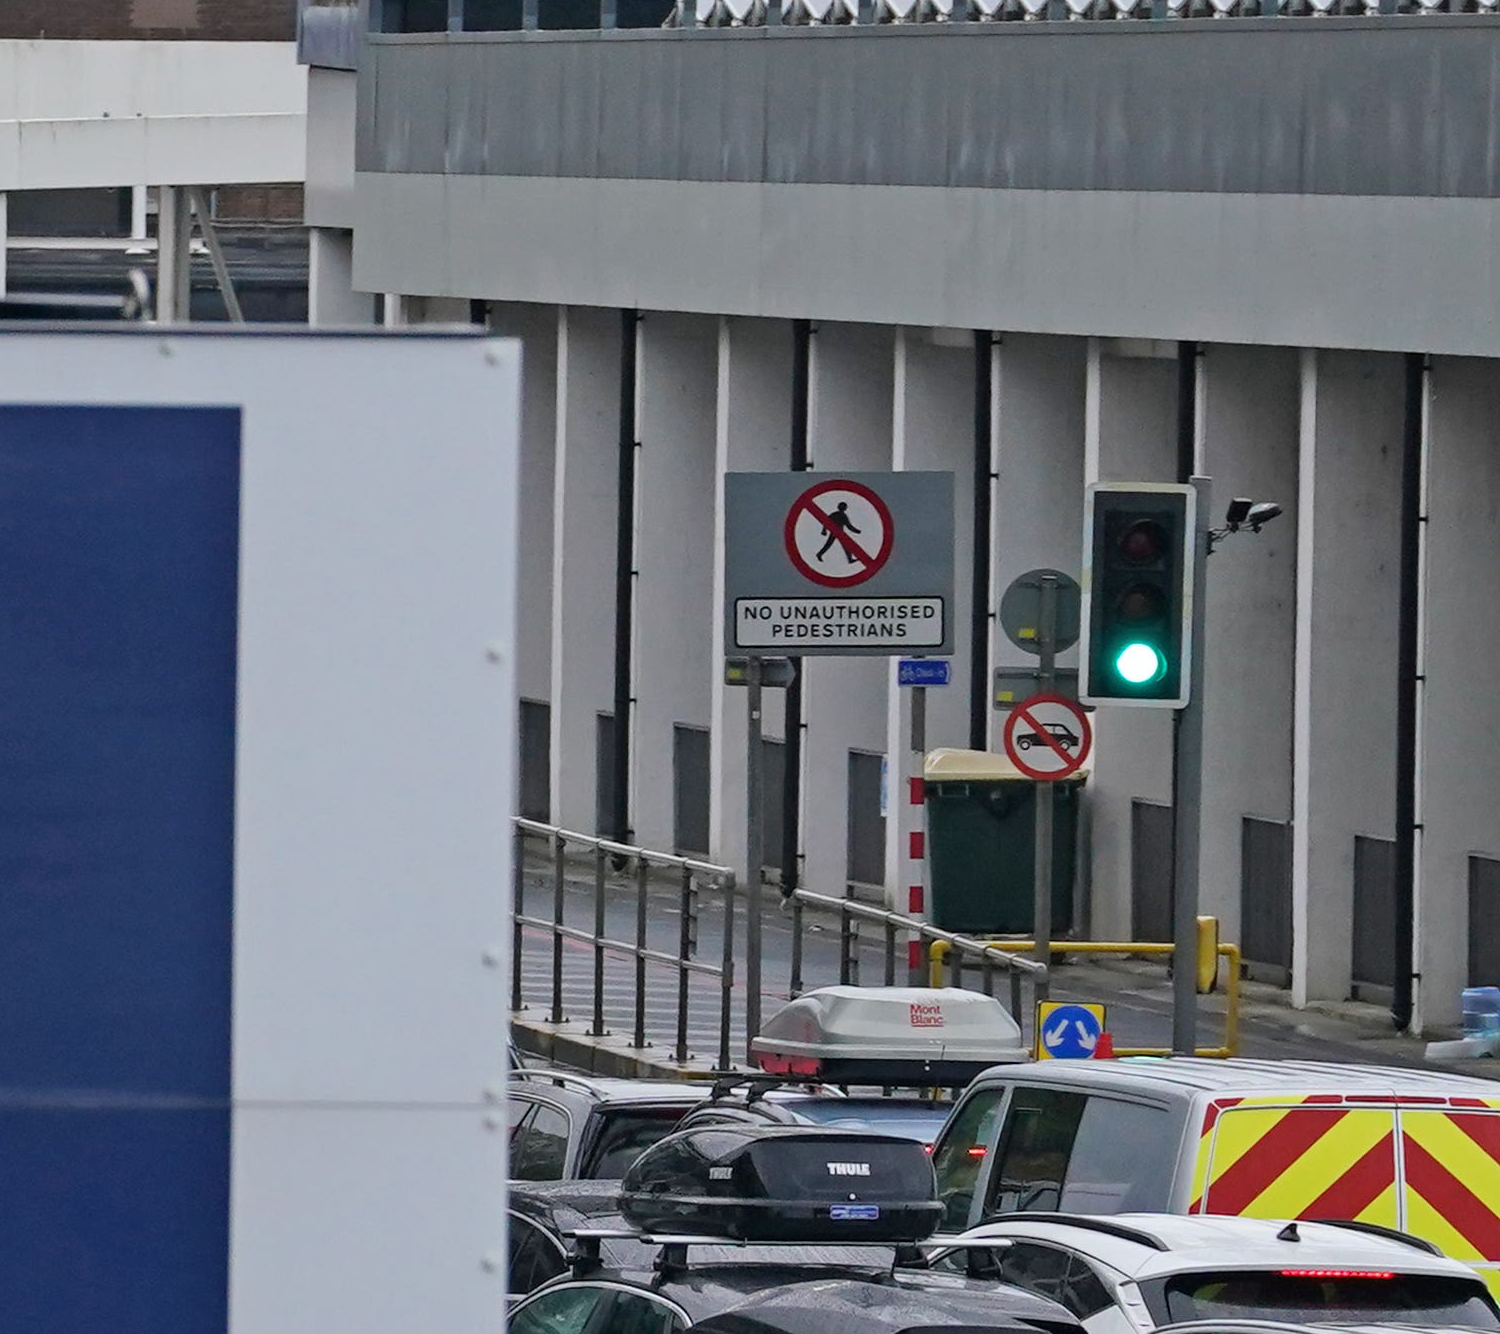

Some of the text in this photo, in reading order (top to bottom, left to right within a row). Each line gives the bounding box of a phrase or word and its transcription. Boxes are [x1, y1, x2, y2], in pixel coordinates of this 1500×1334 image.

[744, 606, 935, 622] NO UNAUTHORISED
[771, 623, 907, 638] PEDESTRIANS
[910, 1004, 941, 1015] Mont
[911, 1015, 944, 1026] Blanc
[826, 1162, 871, 1176] THULE
